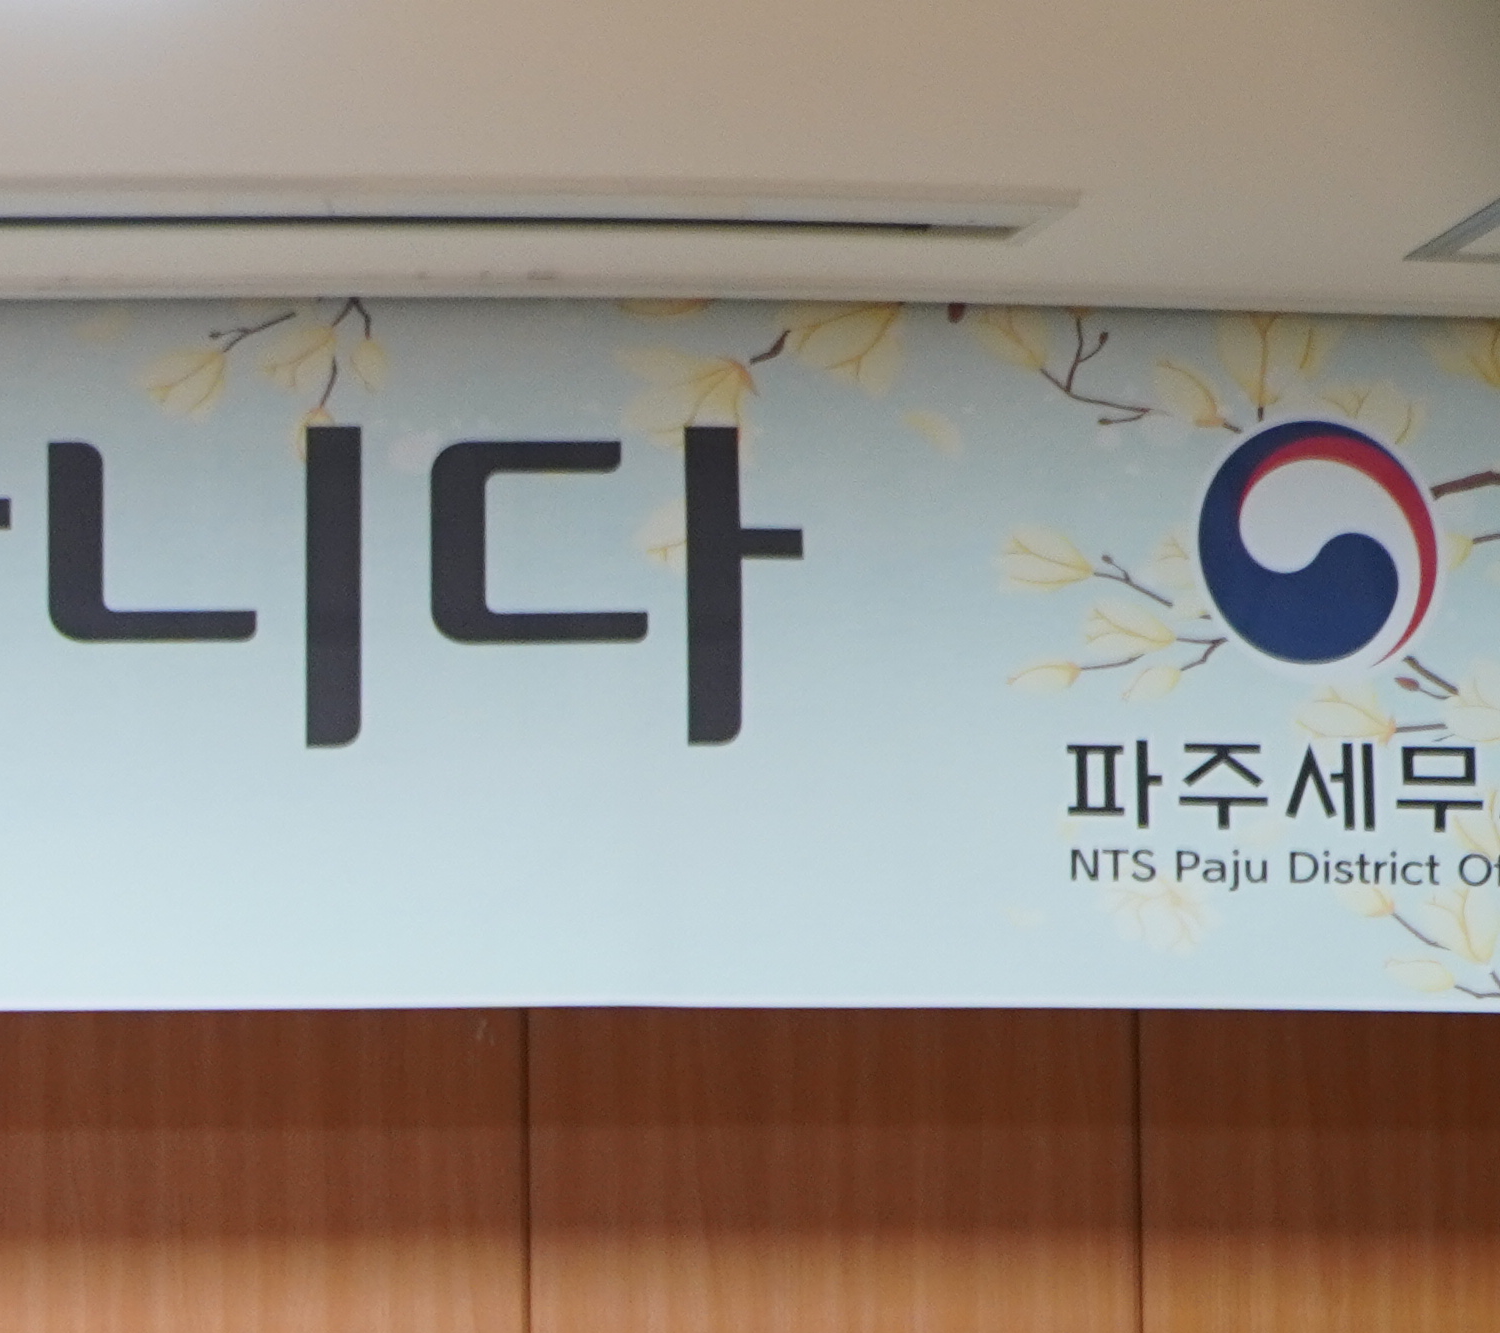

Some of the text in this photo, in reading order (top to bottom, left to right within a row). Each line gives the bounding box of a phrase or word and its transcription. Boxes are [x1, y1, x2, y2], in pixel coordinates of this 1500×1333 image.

[1066, 739, 1500, 832] 파주세무
[1070, 848, 1157, 882] NTS
[1175, 850, 1268, 891] Paju
[1289, 851, 1440, 886] District
